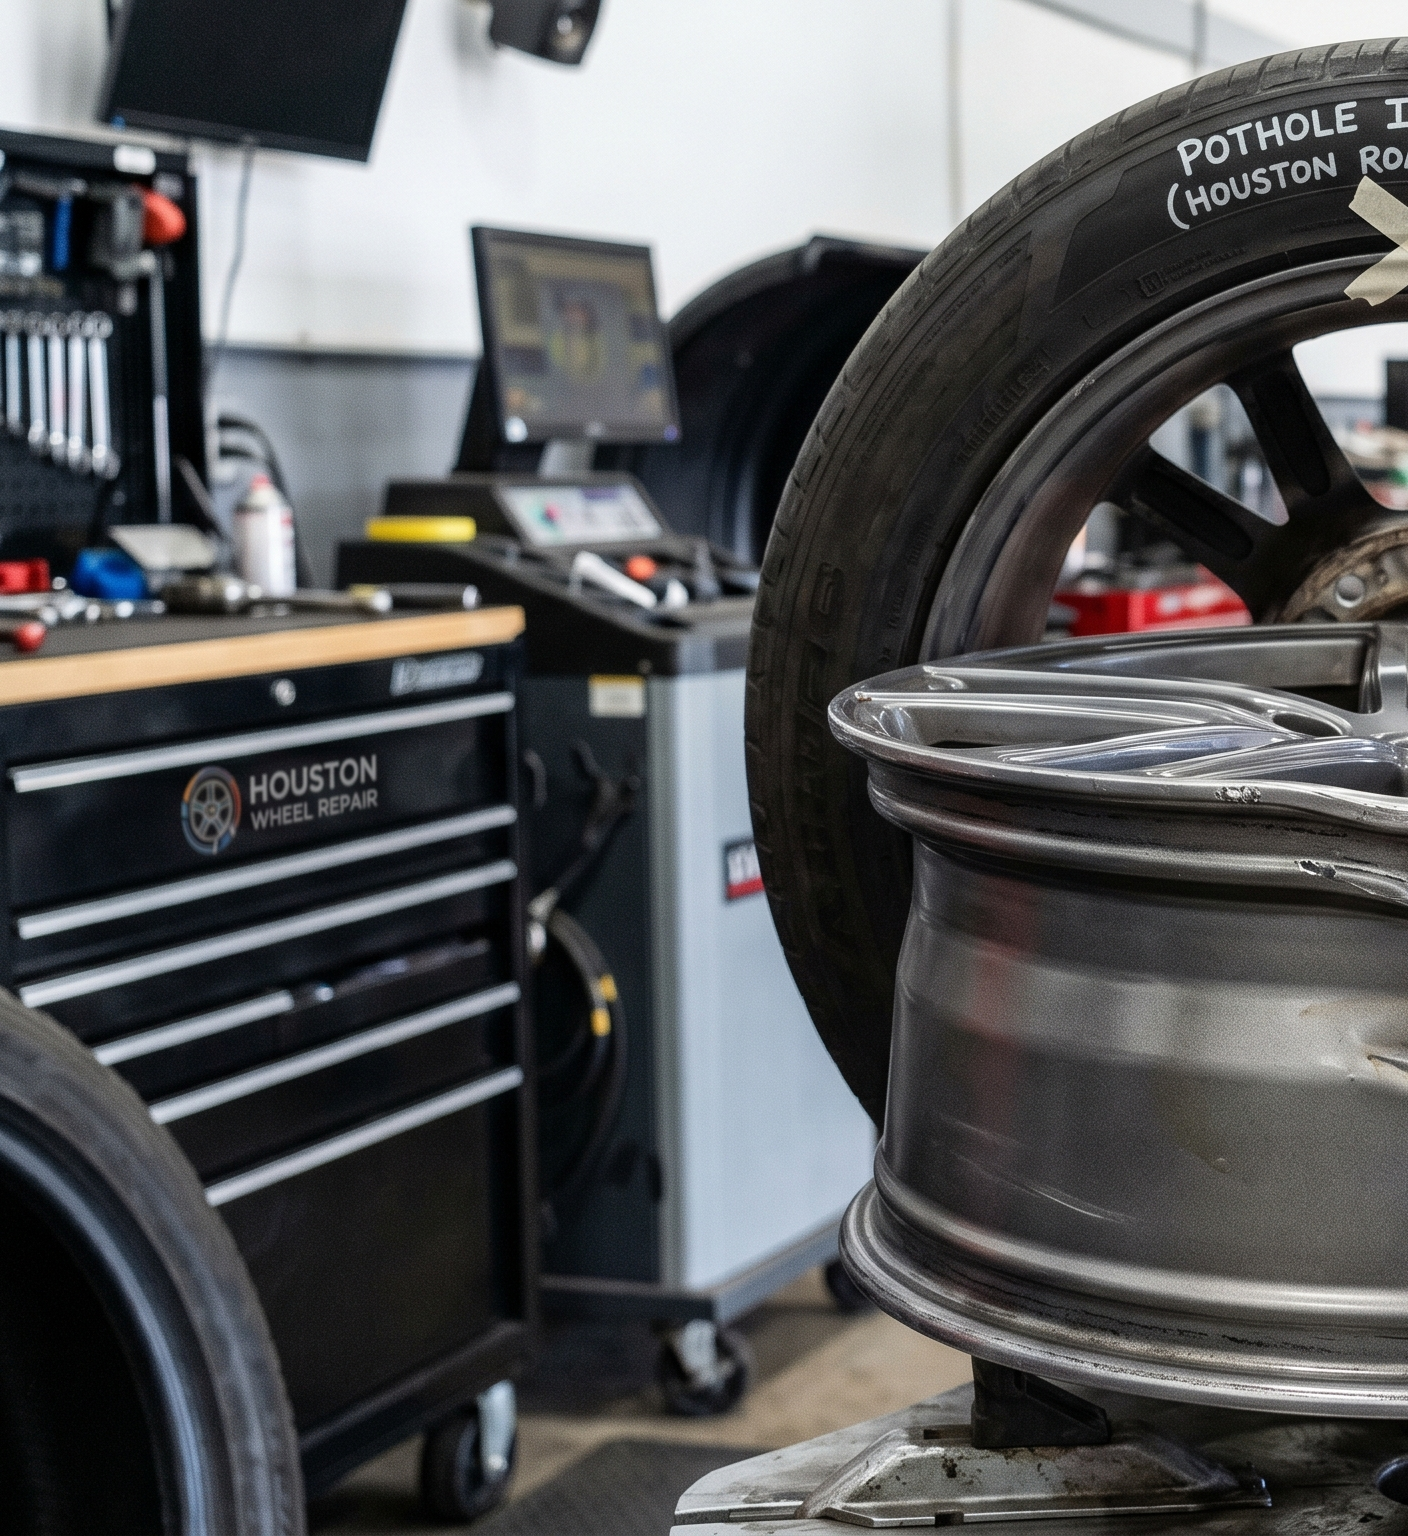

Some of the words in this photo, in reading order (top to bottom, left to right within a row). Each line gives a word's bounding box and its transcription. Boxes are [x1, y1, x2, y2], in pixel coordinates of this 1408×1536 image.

[1176, 100, 1359, 177] POTHOLE
[1166, 151, 1338, 230] (HOUSTON
[249, 754, 378, 805] HOUSTON
[250, 800, 314, 831] WHEEL
[317, 788, 379, 818] REPAIR
